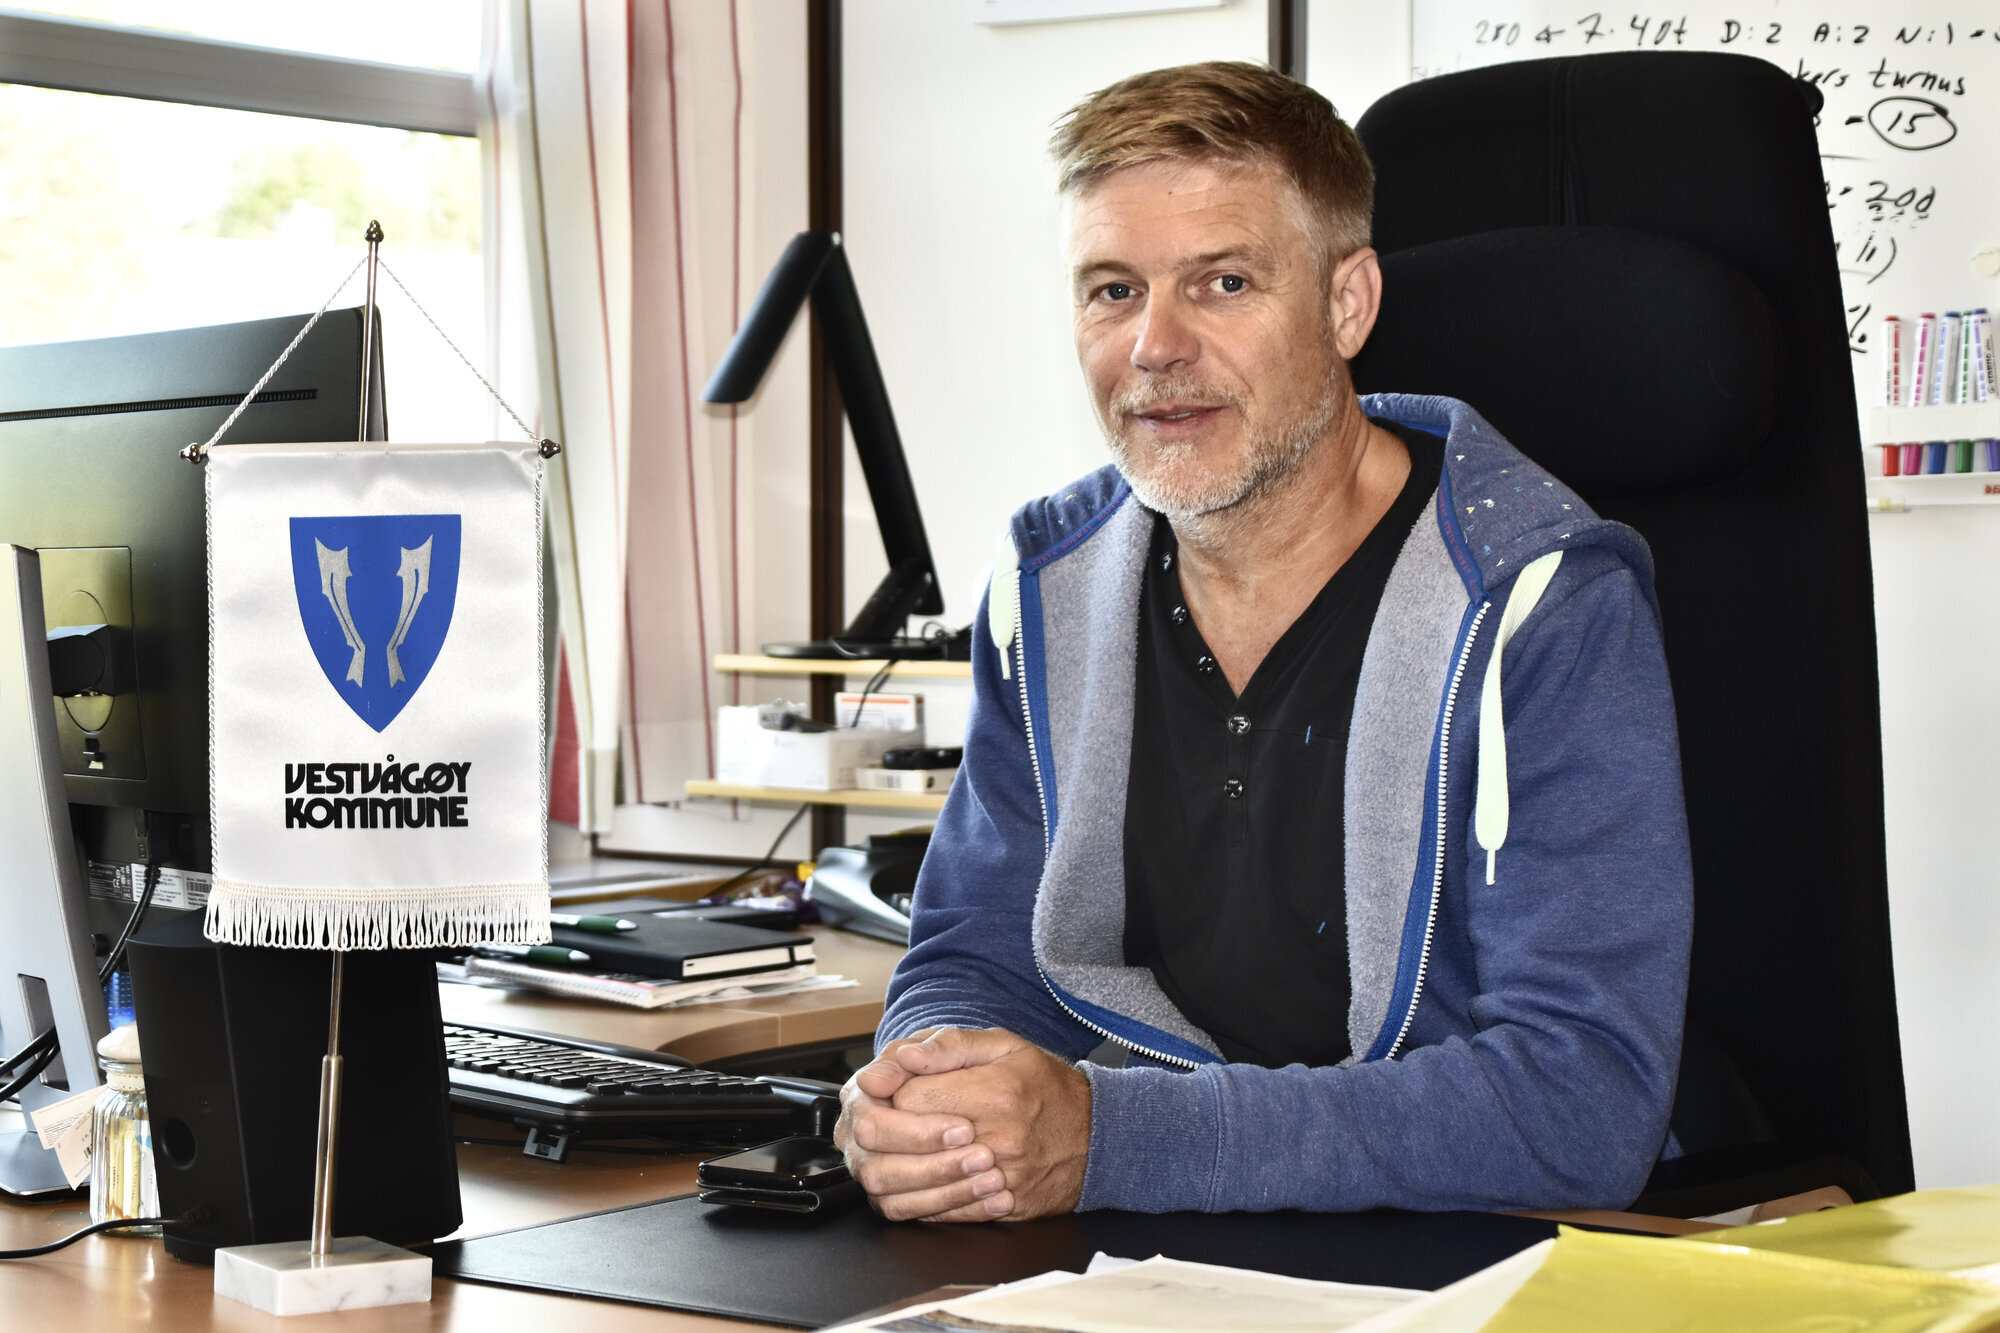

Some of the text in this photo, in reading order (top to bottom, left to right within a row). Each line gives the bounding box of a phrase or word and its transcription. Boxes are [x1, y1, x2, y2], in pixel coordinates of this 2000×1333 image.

[1868, 57, 1966, 96] turnus
[285, 753, 472, 794] VESTVÅGØY
[285, 796, 469, 829] KOMMUNE
